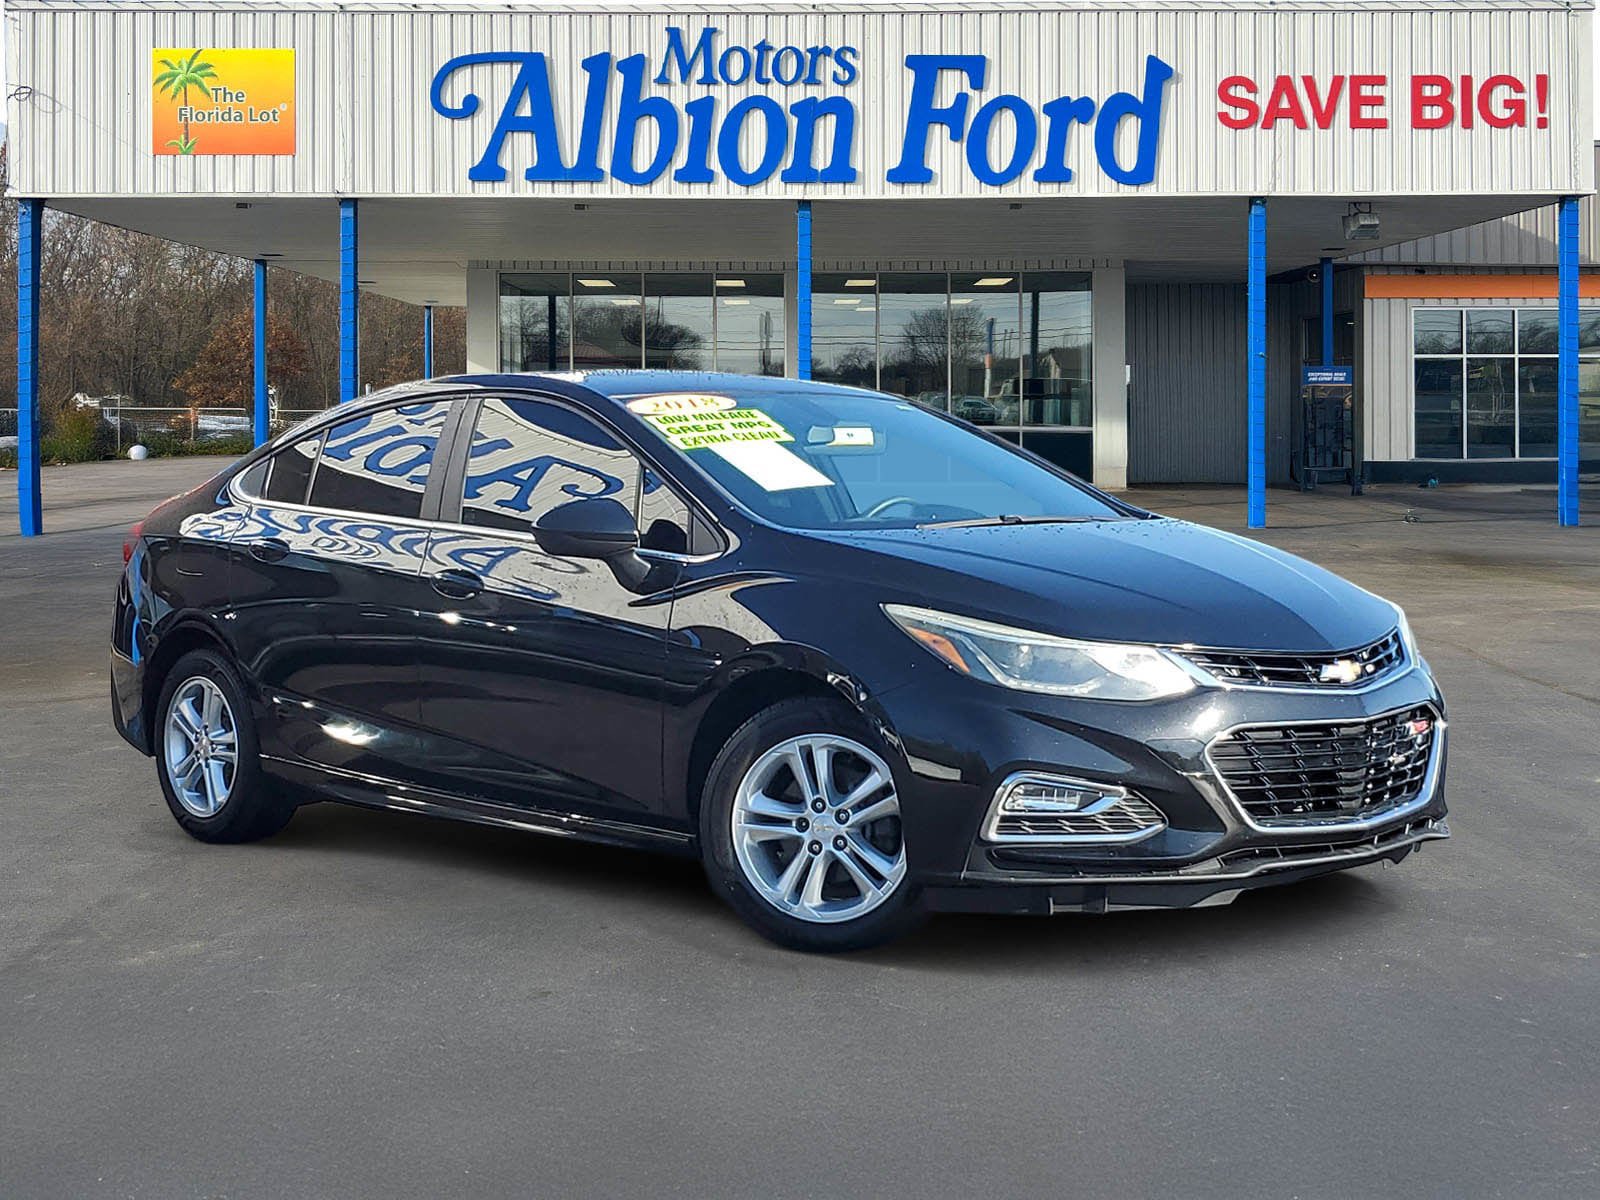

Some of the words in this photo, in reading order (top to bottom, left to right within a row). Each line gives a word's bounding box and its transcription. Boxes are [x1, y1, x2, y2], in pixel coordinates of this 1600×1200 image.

[656, 27, 857, 85] Motors
[211, 87, 246, 103] The
[1217, 75, 1388, 129] SAVE
[1411, 75, 1548, 129] BIG!
[178, 107, 243, 122] Florida
[249, 107, 279, 122] Lot
[430, 52, 858, 186] Albion
[886, 55, 1174, 186] Ford
[656, 414, 690, 425] LOW
[691, 410, 759, 422] MILEAGE
[666, 422, 725, 435] GREAT
[730, 420, 772, 430] MPG
[680, 433, 731, 447] EXTRA
[732, 430, 781, 441] CLEAN
